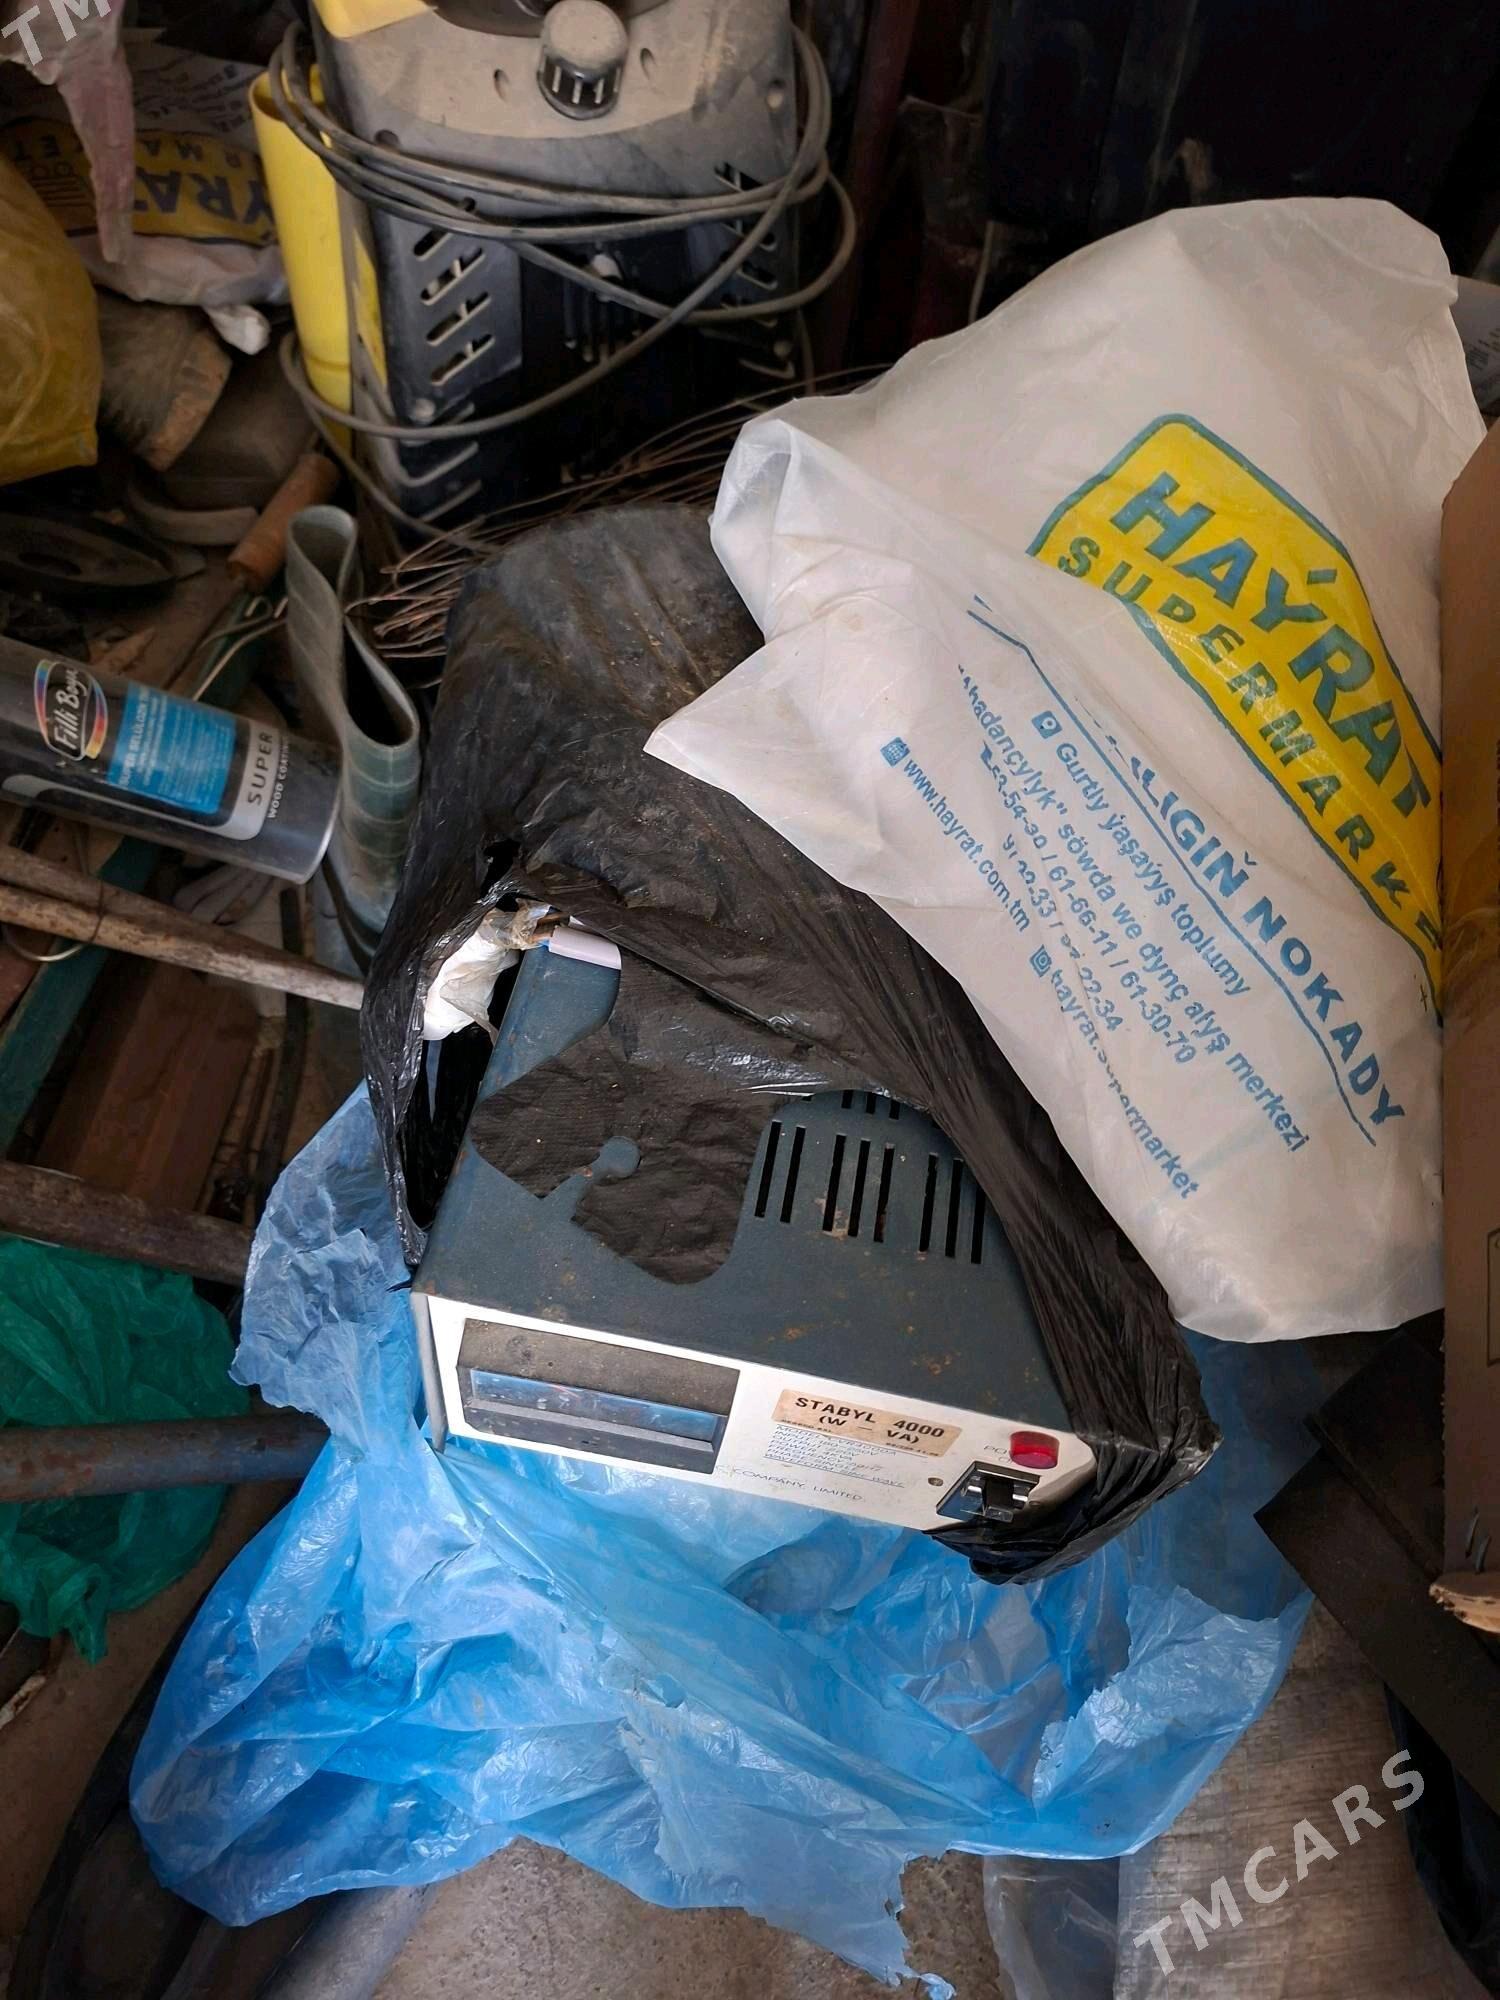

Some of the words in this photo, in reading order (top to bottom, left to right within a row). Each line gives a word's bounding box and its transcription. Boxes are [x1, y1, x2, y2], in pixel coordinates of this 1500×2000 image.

[54, 706, 80, 750] Filli
[247, 731, 274, 806] SUPER
[268, 782, 284, 819] WOOD
[904, 759, 1030, 932] www.hayrat.com.tm
[1056, 743, 1109, 811] Gurtly
[1171, 902, 1248, 996] toplumy
[1048, 866, 1118, 956] 61-66-11
[1120, 971, 1197, 1064] 61-30-70
[1058, 824, 1116, 902] söwda
[1112, 902, 1142, 939] we
[1139, 943, 1189, 1002] dynç
[1184, 1001, 1230, 1055] alyş
[1225, 1052, 1307, 1152] merkezi
[1240, 896, 1404, 1126] NOKADY
[795, 1397, 877, 1424] STABYL
[892, 1420, 945, 1438] 4000
[819, 1415, 847, 1427] (W
[887, 1430, 919, 1444] VA)
